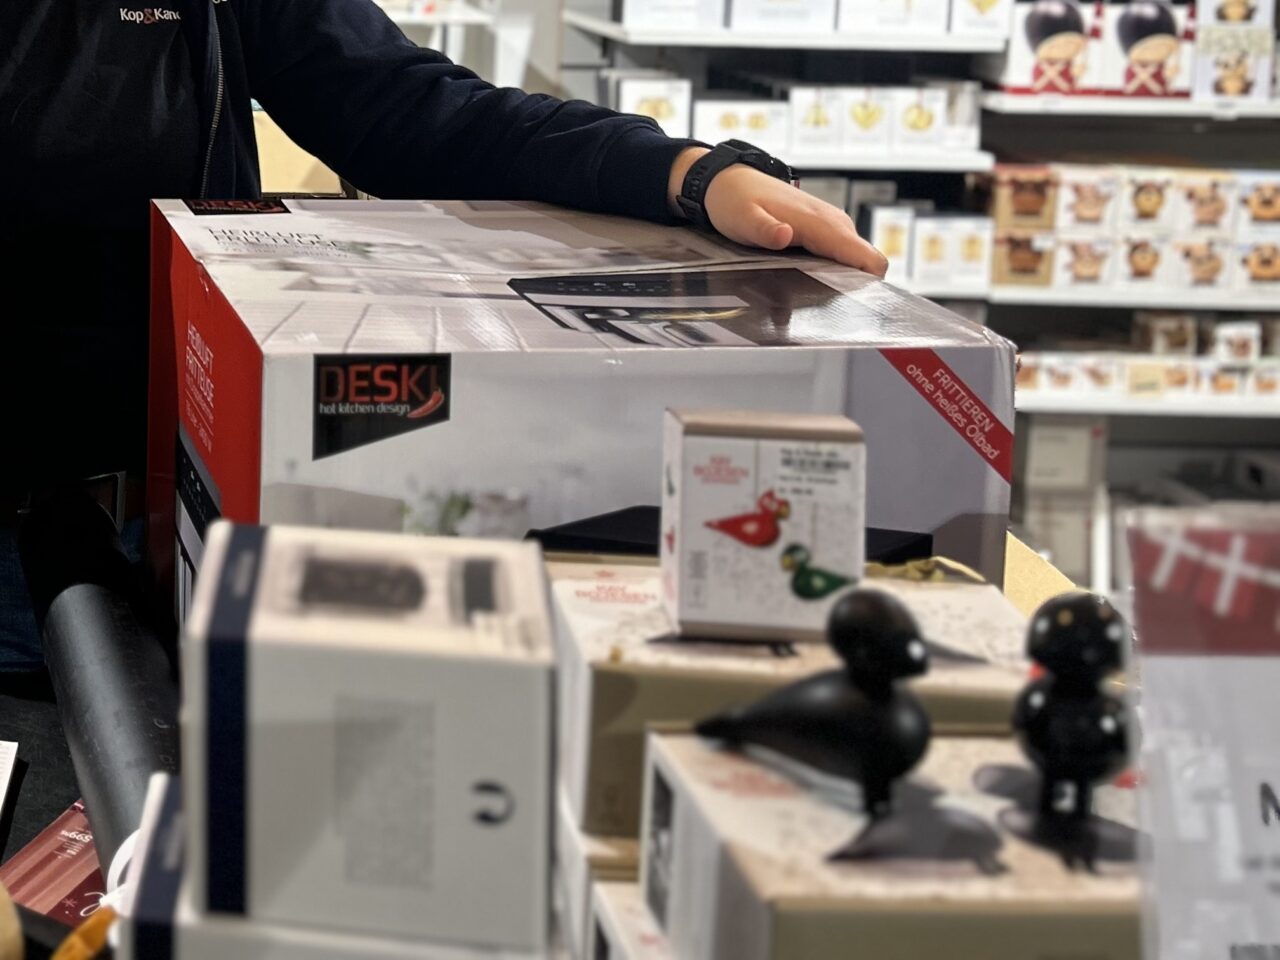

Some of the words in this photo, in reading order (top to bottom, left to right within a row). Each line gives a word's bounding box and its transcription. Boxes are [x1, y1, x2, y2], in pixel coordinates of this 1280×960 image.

[119, 7, 182, 24] Kop&Kan
[319, 402, 336, 415] hot
[338, 402, 375, 414] kitchen
[376, 402, 411, 416] design
[906, 364, 935, 394] ohne
[932, 390, 968, 428] heißes
[932, 368, 995, 432] FRITTIEREN
